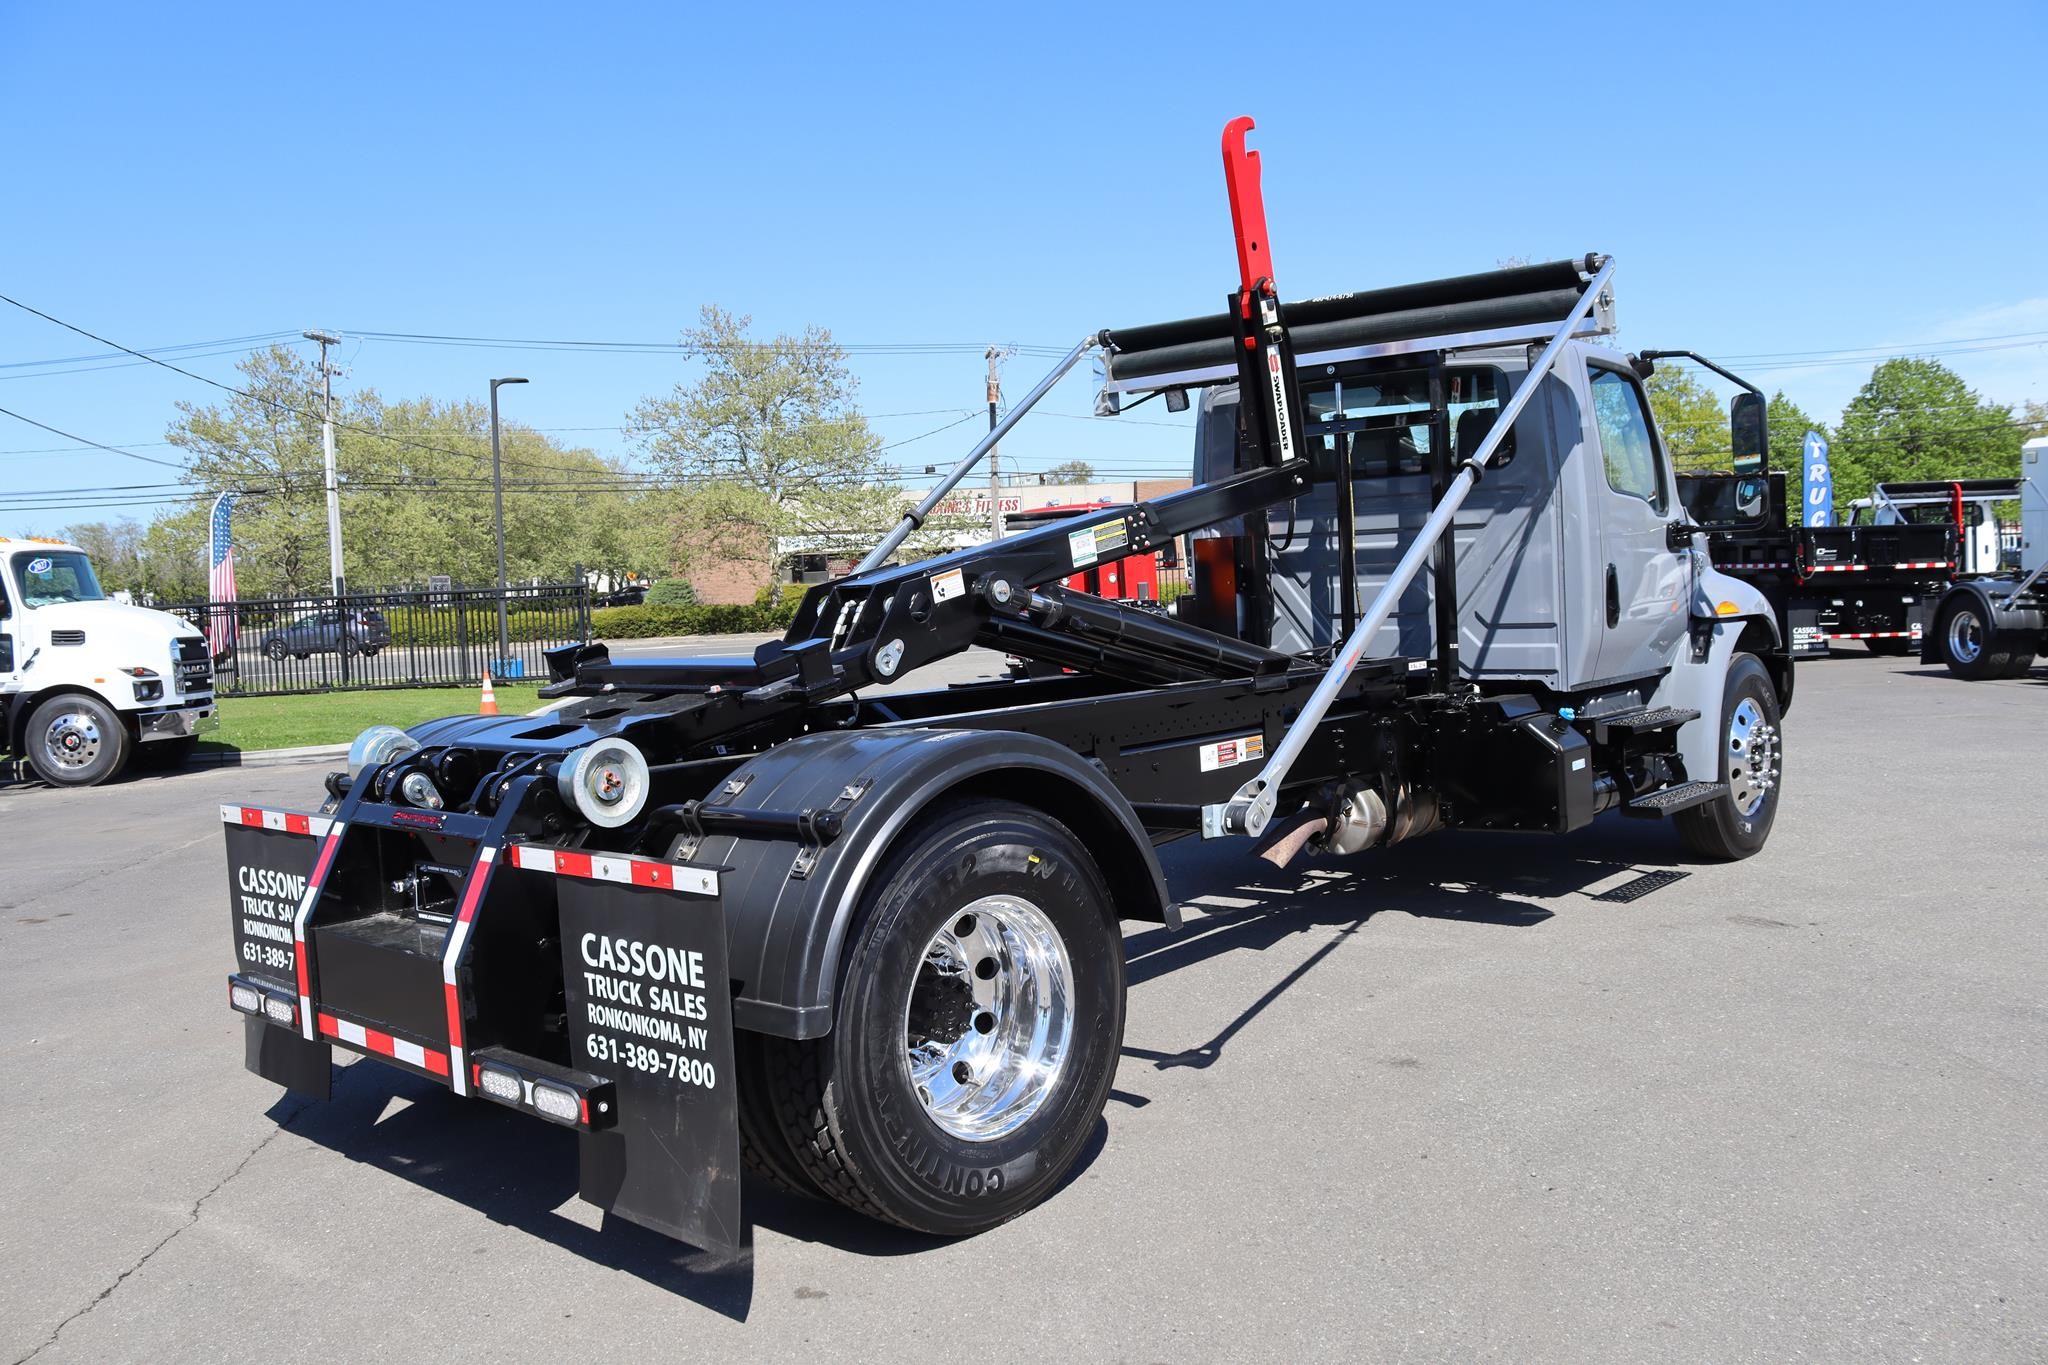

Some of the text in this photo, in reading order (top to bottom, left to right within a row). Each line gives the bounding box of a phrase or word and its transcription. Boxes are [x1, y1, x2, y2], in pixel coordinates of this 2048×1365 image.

[1272, 375, 1289, 451] SWAPLOADER
[975, 499, 1019, 513] FITESS
[239, 865, 306, 902] CASSONE
[240, 895, 276, 919] TRUCK
[581, 932, 706, 989] CASSONE
[583, 971, 708, 1021] TRUCK SALES
[587, 1002, 708, 1051] RONKONKOMA, NY
[586, 1033, 716, 1090] 631-389-7800
